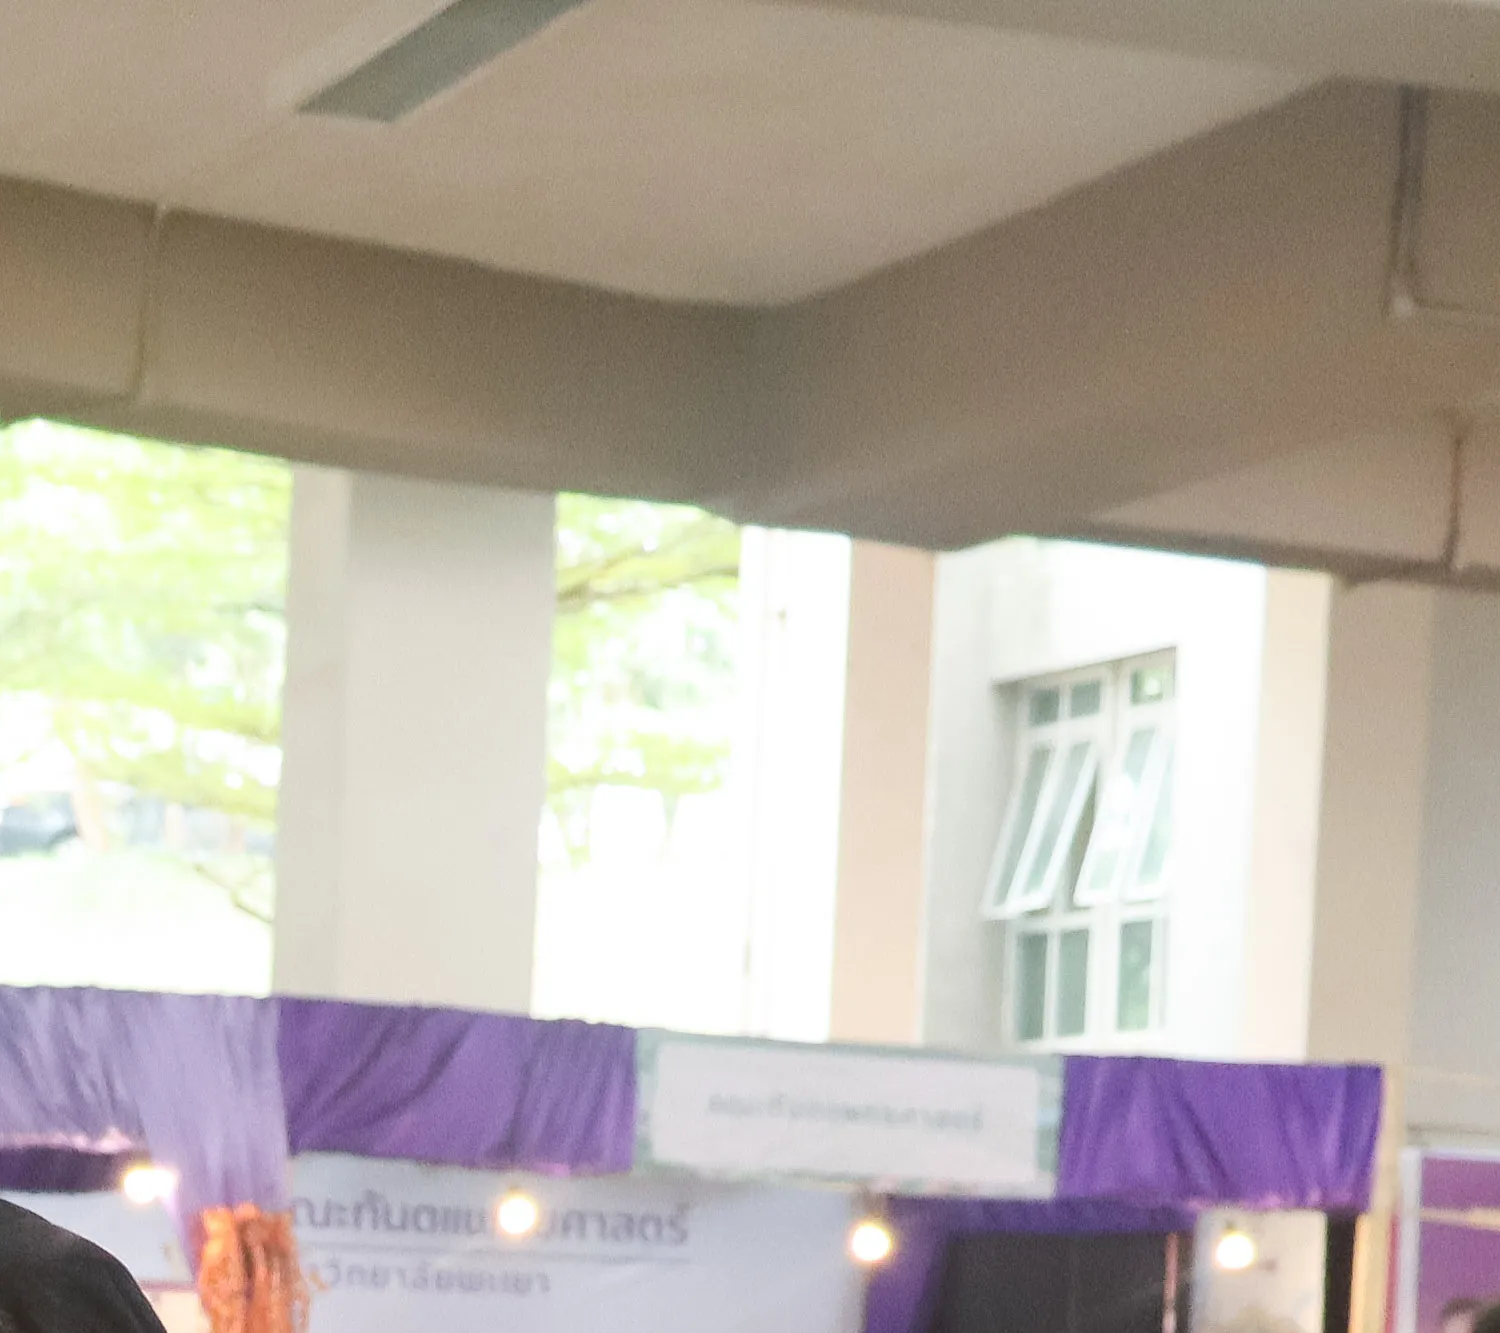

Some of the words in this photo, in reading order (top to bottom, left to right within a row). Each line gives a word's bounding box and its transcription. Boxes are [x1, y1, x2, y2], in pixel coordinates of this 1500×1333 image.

[320, 1256, 552, 1296] วิทยาลัยพะเยา
